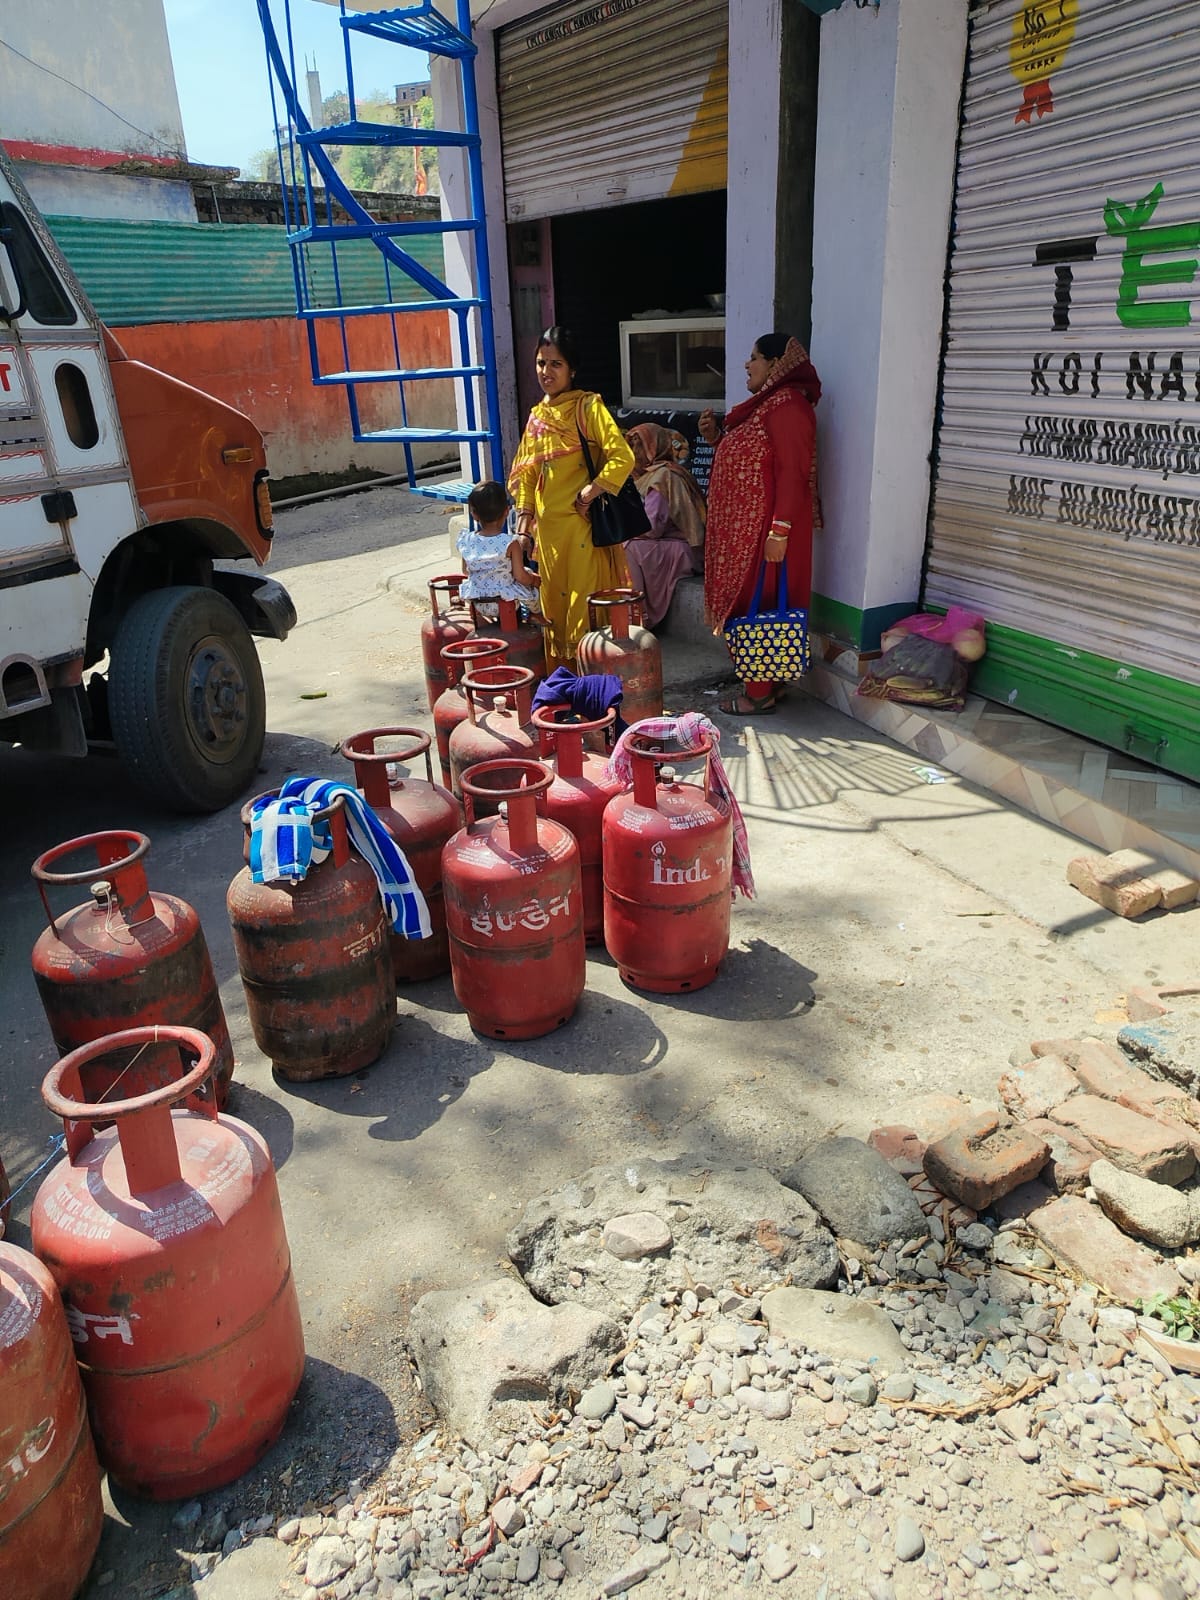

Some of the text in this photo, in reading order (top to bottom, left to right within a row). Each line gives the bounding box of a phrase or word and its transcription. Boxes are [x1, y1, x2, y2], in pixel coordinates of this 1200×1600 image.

[1031, 352, 1200, 402] KOI NA
[1057, 484, 1200, 547] BOARD/PARTI
